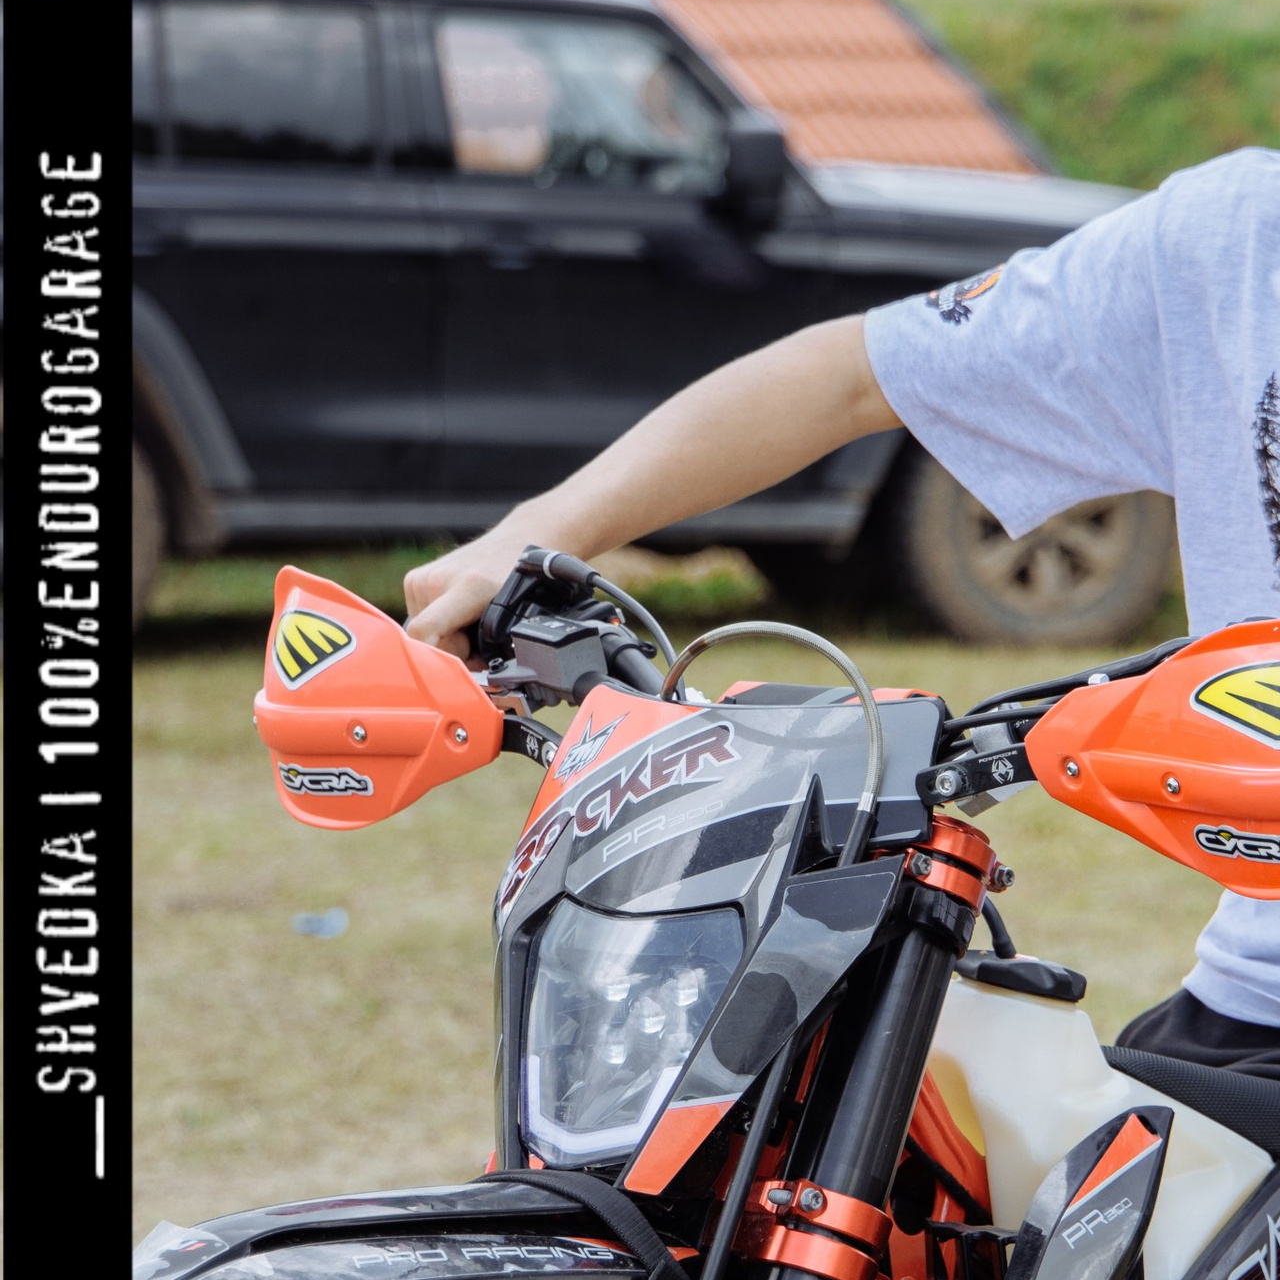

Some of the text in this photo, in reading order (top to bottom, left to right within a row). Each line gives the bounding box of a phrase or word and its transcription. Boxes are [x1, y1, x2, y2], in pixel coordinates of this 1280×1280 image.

[280, 767, 366, 791] CYCRA
[501, 721, 743, 913] ROCKER
[351, 1245, 615, 1270] PRO RACING
